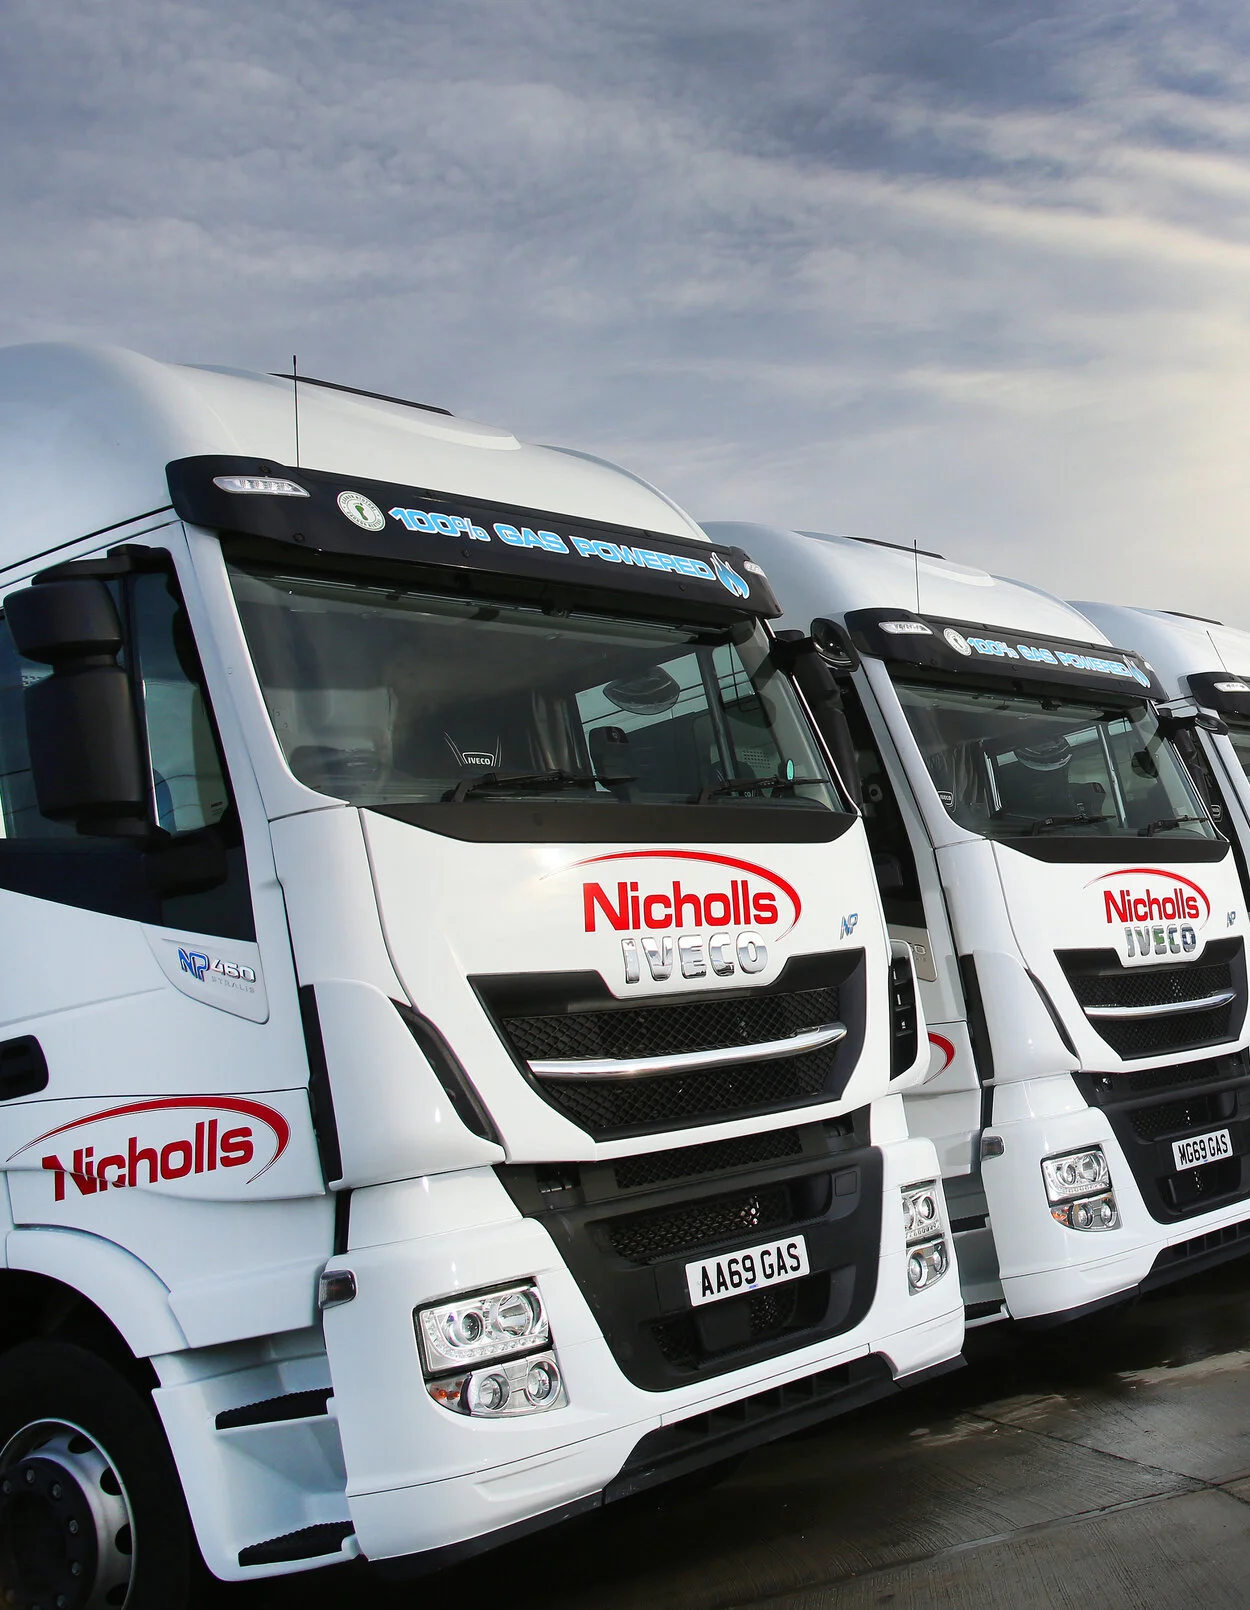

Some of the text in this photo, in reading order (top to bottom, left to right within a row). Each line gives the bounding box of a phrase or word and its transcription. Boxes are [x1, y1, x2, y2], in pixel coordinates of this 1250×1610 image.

[388, 506, 716, 581] 100% GAS POWERED
[967, 637, 1020, 659] 100%
[1017, 644, 1058, 665] GAS
[1055, 650, 1132, 678] POWERED
[467, 757, 491, 765] IVECO
[583, 880, 778, 932] Nicholls
[1103, 888, 1199, 924] Nicholls
[840, 912, 858, 940] NP
[1124, 923, 1197, 957] IVECO
[177, 947, 210, 982] NP
[621, 931, 768, 984] IVECO
[42, 1118, 254, 1202] Nicholls
[1178, 1133, 1228, 1165] MG69 GAS
[701, 1242, 801, 1297] AA69 GAS
